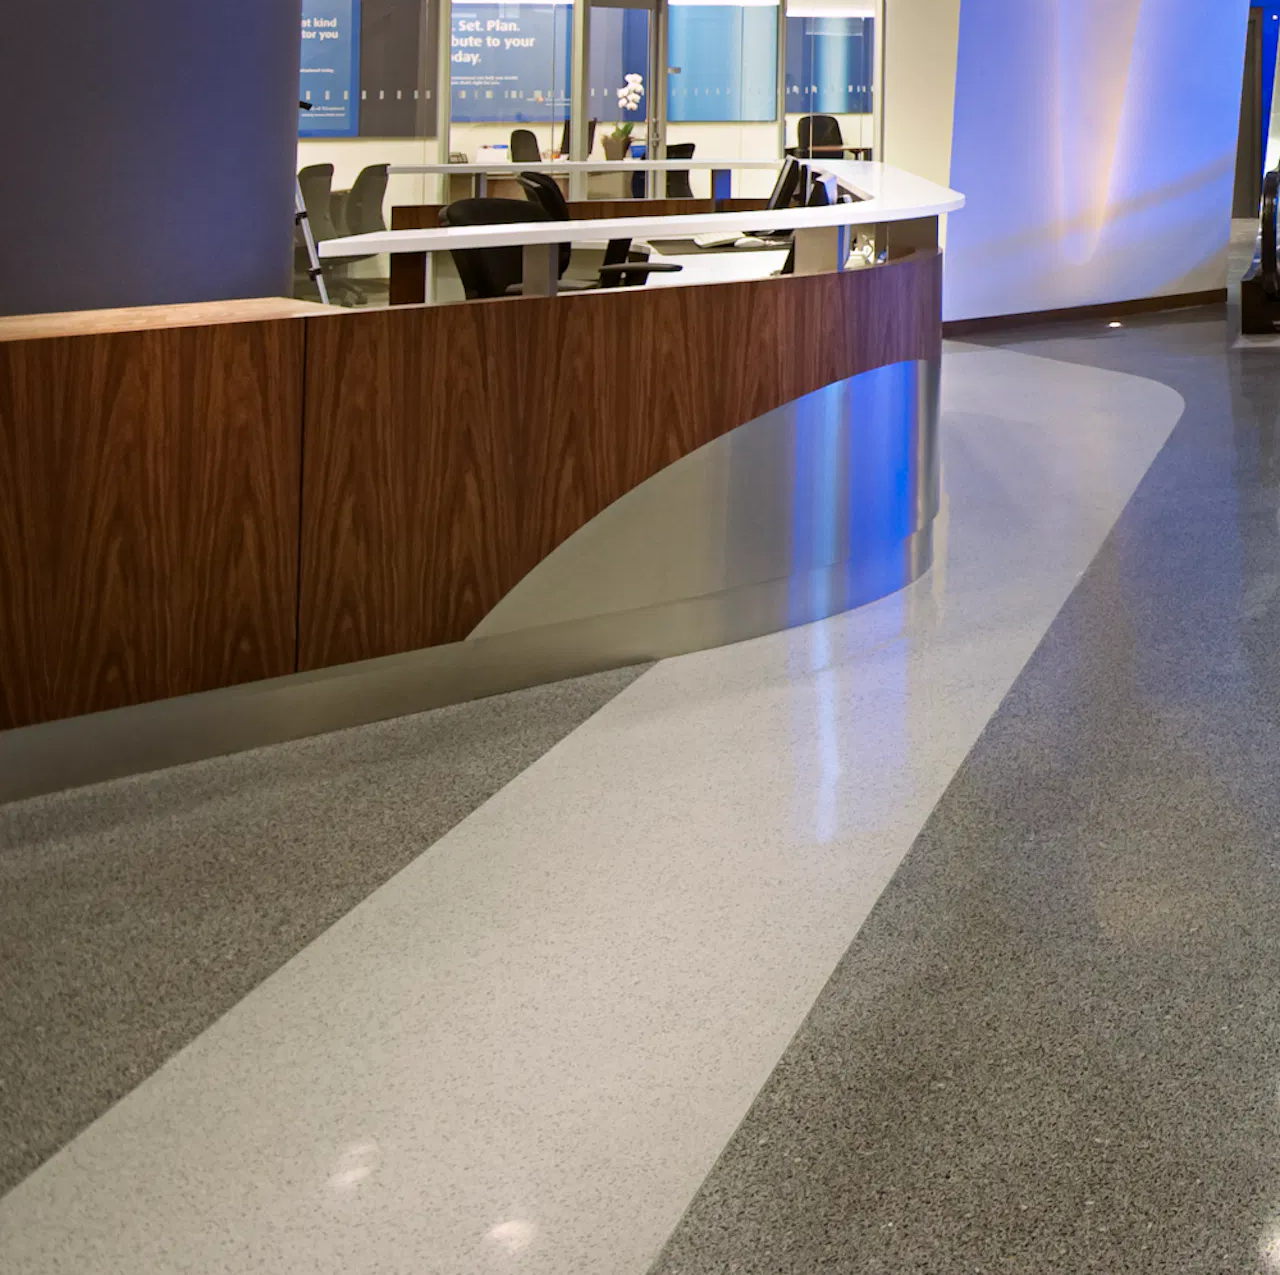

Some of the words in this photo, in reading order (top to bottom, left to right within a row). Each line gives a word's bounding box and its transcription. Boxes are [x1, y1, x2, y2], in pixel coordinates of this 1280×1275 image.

[313, 17, 337, 28] kind
[458, 19, 484, 31] Set.
[487, 19, 520, 31] Plan.
[319, 31, 339, 41] you
[486, 36, 500, 47] to
[504, 37, 535, 49] your
